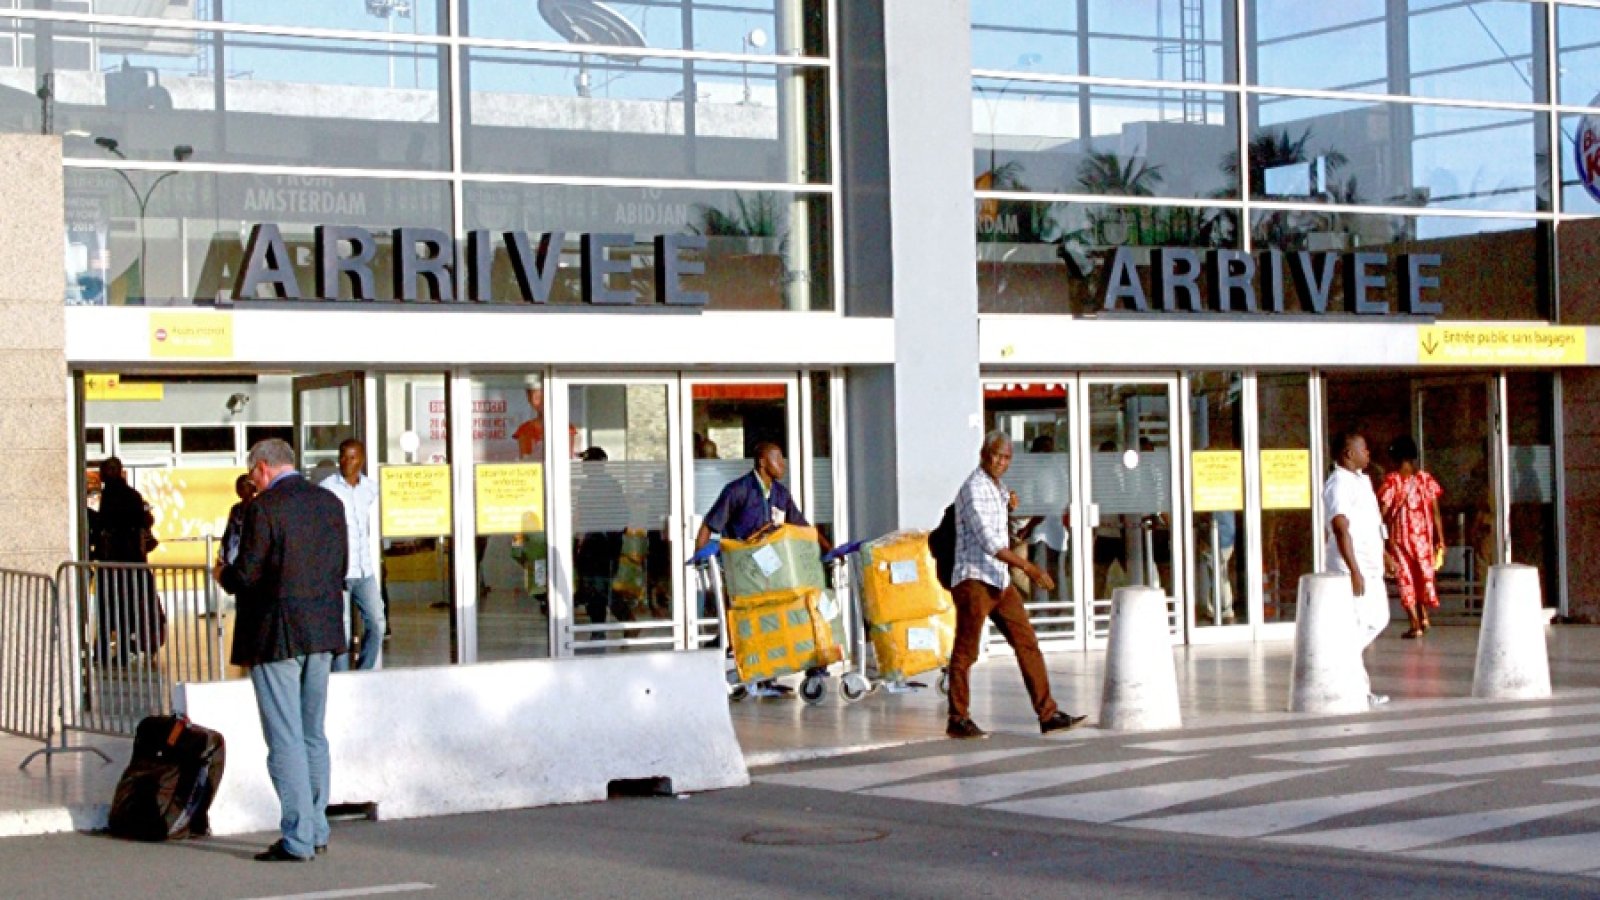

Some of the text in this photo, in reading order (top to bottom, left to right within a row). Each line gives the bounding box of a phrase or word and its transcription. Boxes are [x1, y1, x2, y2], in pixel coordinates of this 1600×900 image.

[244, 188, 367, 215] AMSTERDAM
[615, 202, 687, 225] ABIDJAN
[236, 223, 708, 305] ARRIVEE
[1103, 246, 1443, 314] ARRIVEE
[1443, 330, 1576, 347] Entrée public sans bagages
